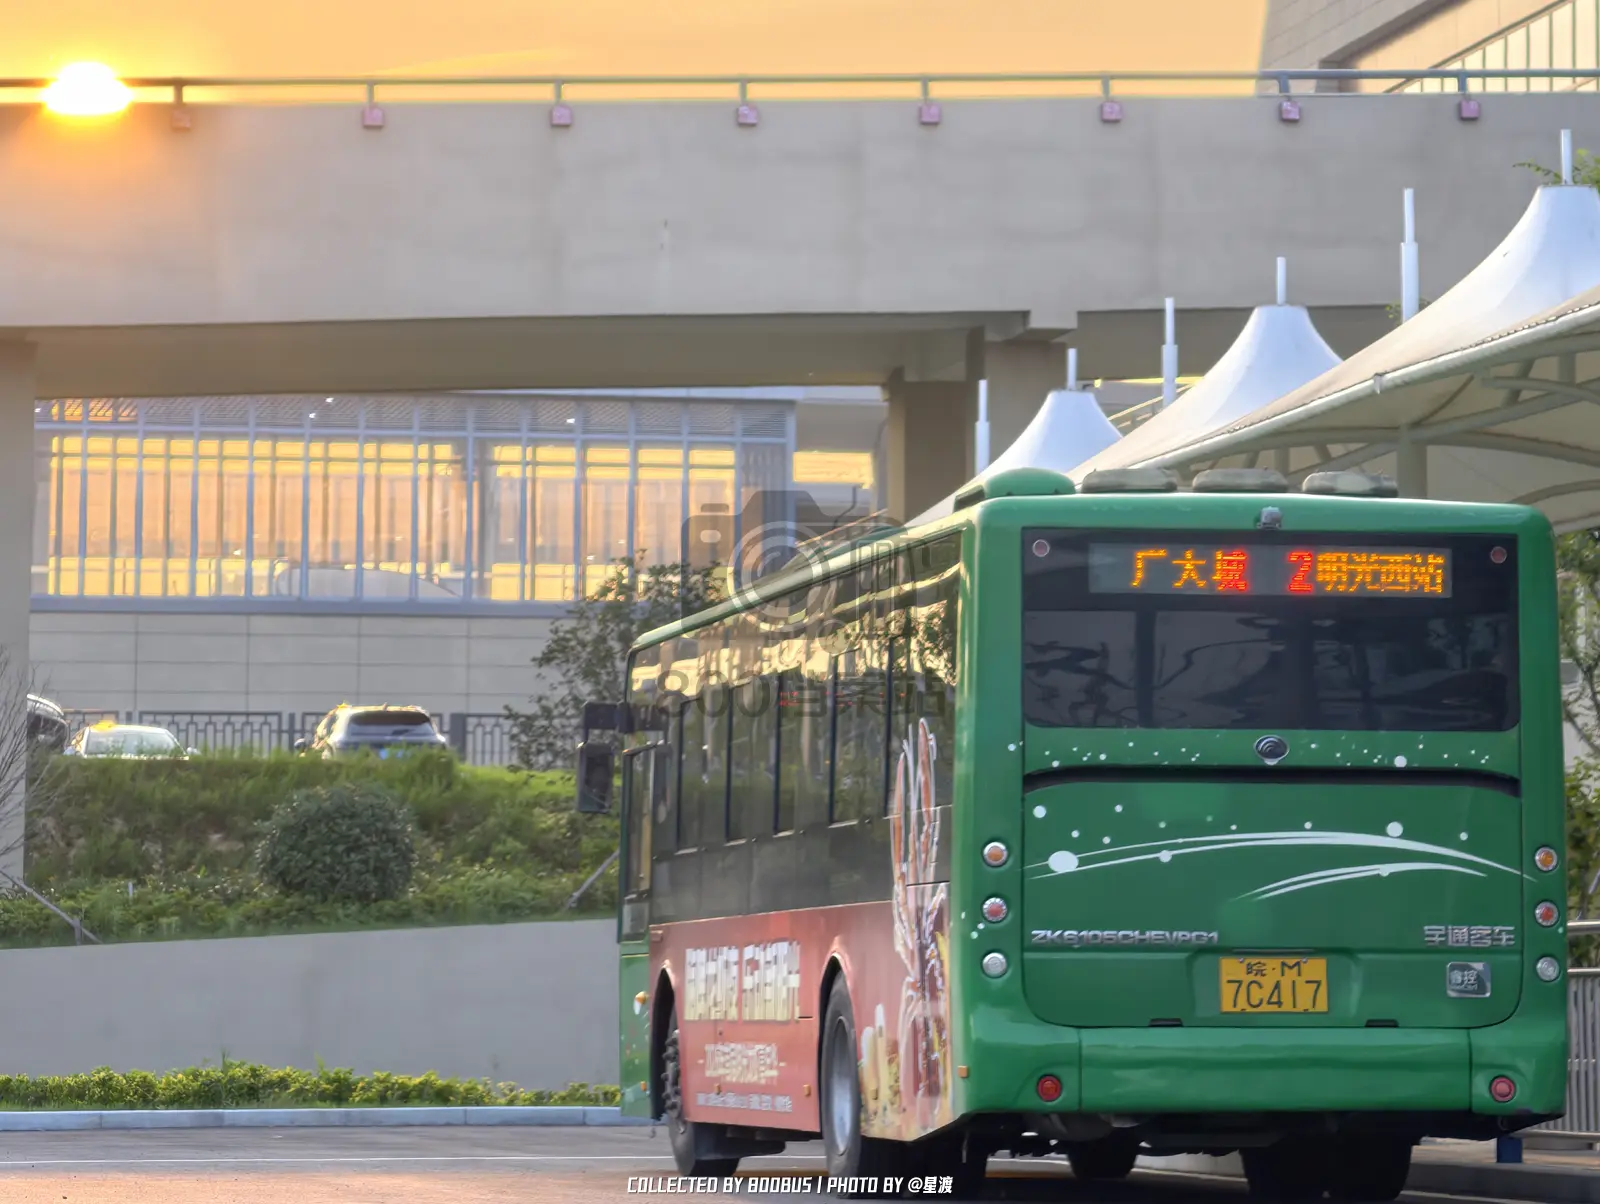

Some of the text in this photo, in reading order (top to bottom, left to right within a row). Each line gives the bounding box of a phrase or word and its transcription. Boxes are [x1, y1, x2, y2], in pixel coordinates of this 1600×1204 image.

[1288, 551, 1313, 592] 2
[1316, 552, 1444, 593] 明光西站
[1031, 929, 1219, 946] ZK6105CHEVPG1
[1423, 925, 1516, 947] 宇通客车
[1226, 980, 1322, 1008] 7C417
